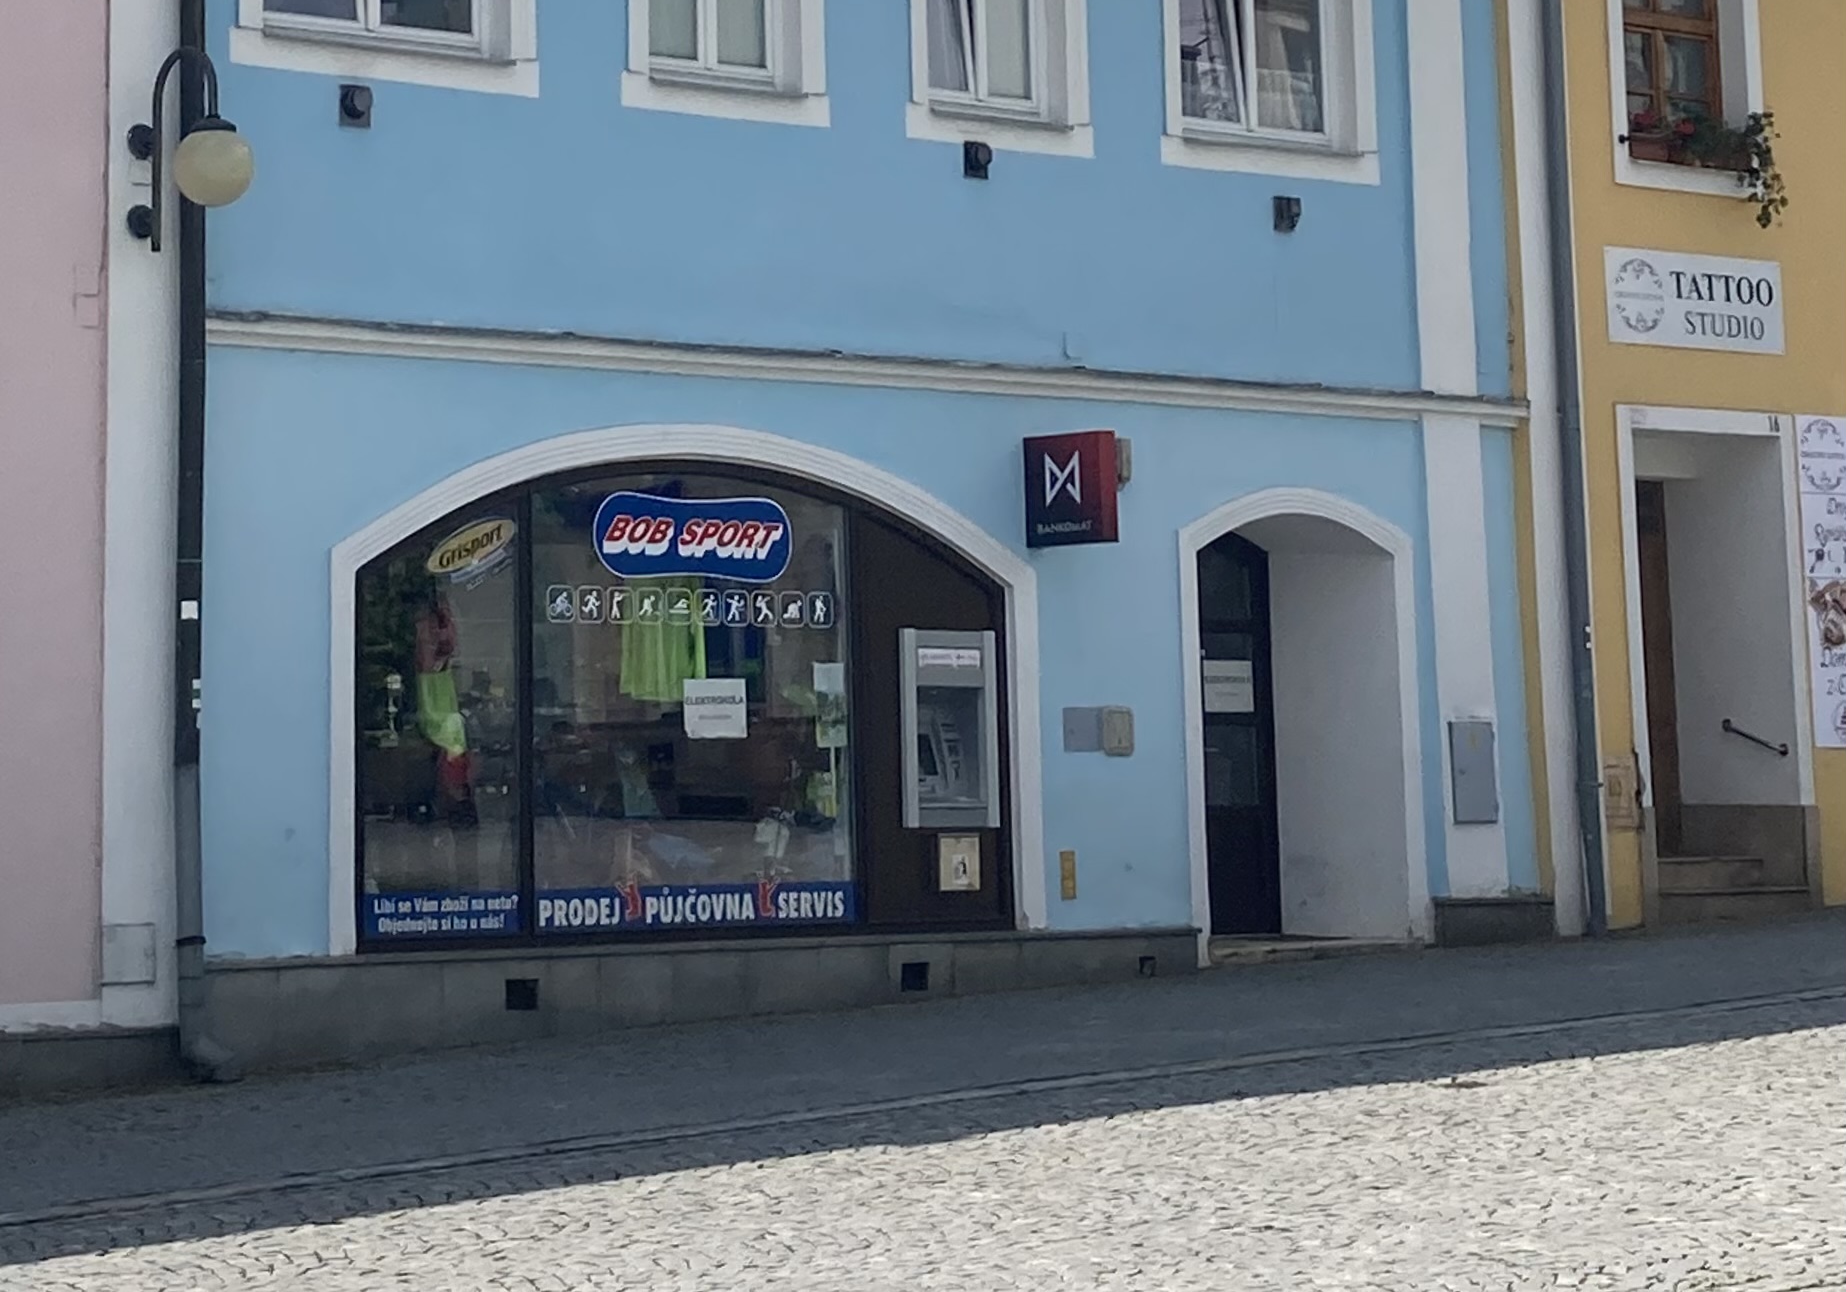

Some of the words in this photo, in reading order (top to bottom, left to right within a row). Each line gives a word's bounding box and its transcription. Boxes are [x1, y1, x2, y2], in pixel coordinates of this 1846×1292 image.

[1669, 270, 1773, 307] TATTOO
[1684, 310, 1765, 340] STUDIO
[439, 523, 503, 568] Grisport
[602, 514, 673, 556] BOB
[679, 519, 783, 559] SPORT
[398, 900, 412, 913] se
[413, 897, 438, 913] Vám
[538, 897, 620, 927] PRODEJ
[645, 886, 755, 924] PŮJČOVNA
[777, 891, 845, 918] SERVIS
